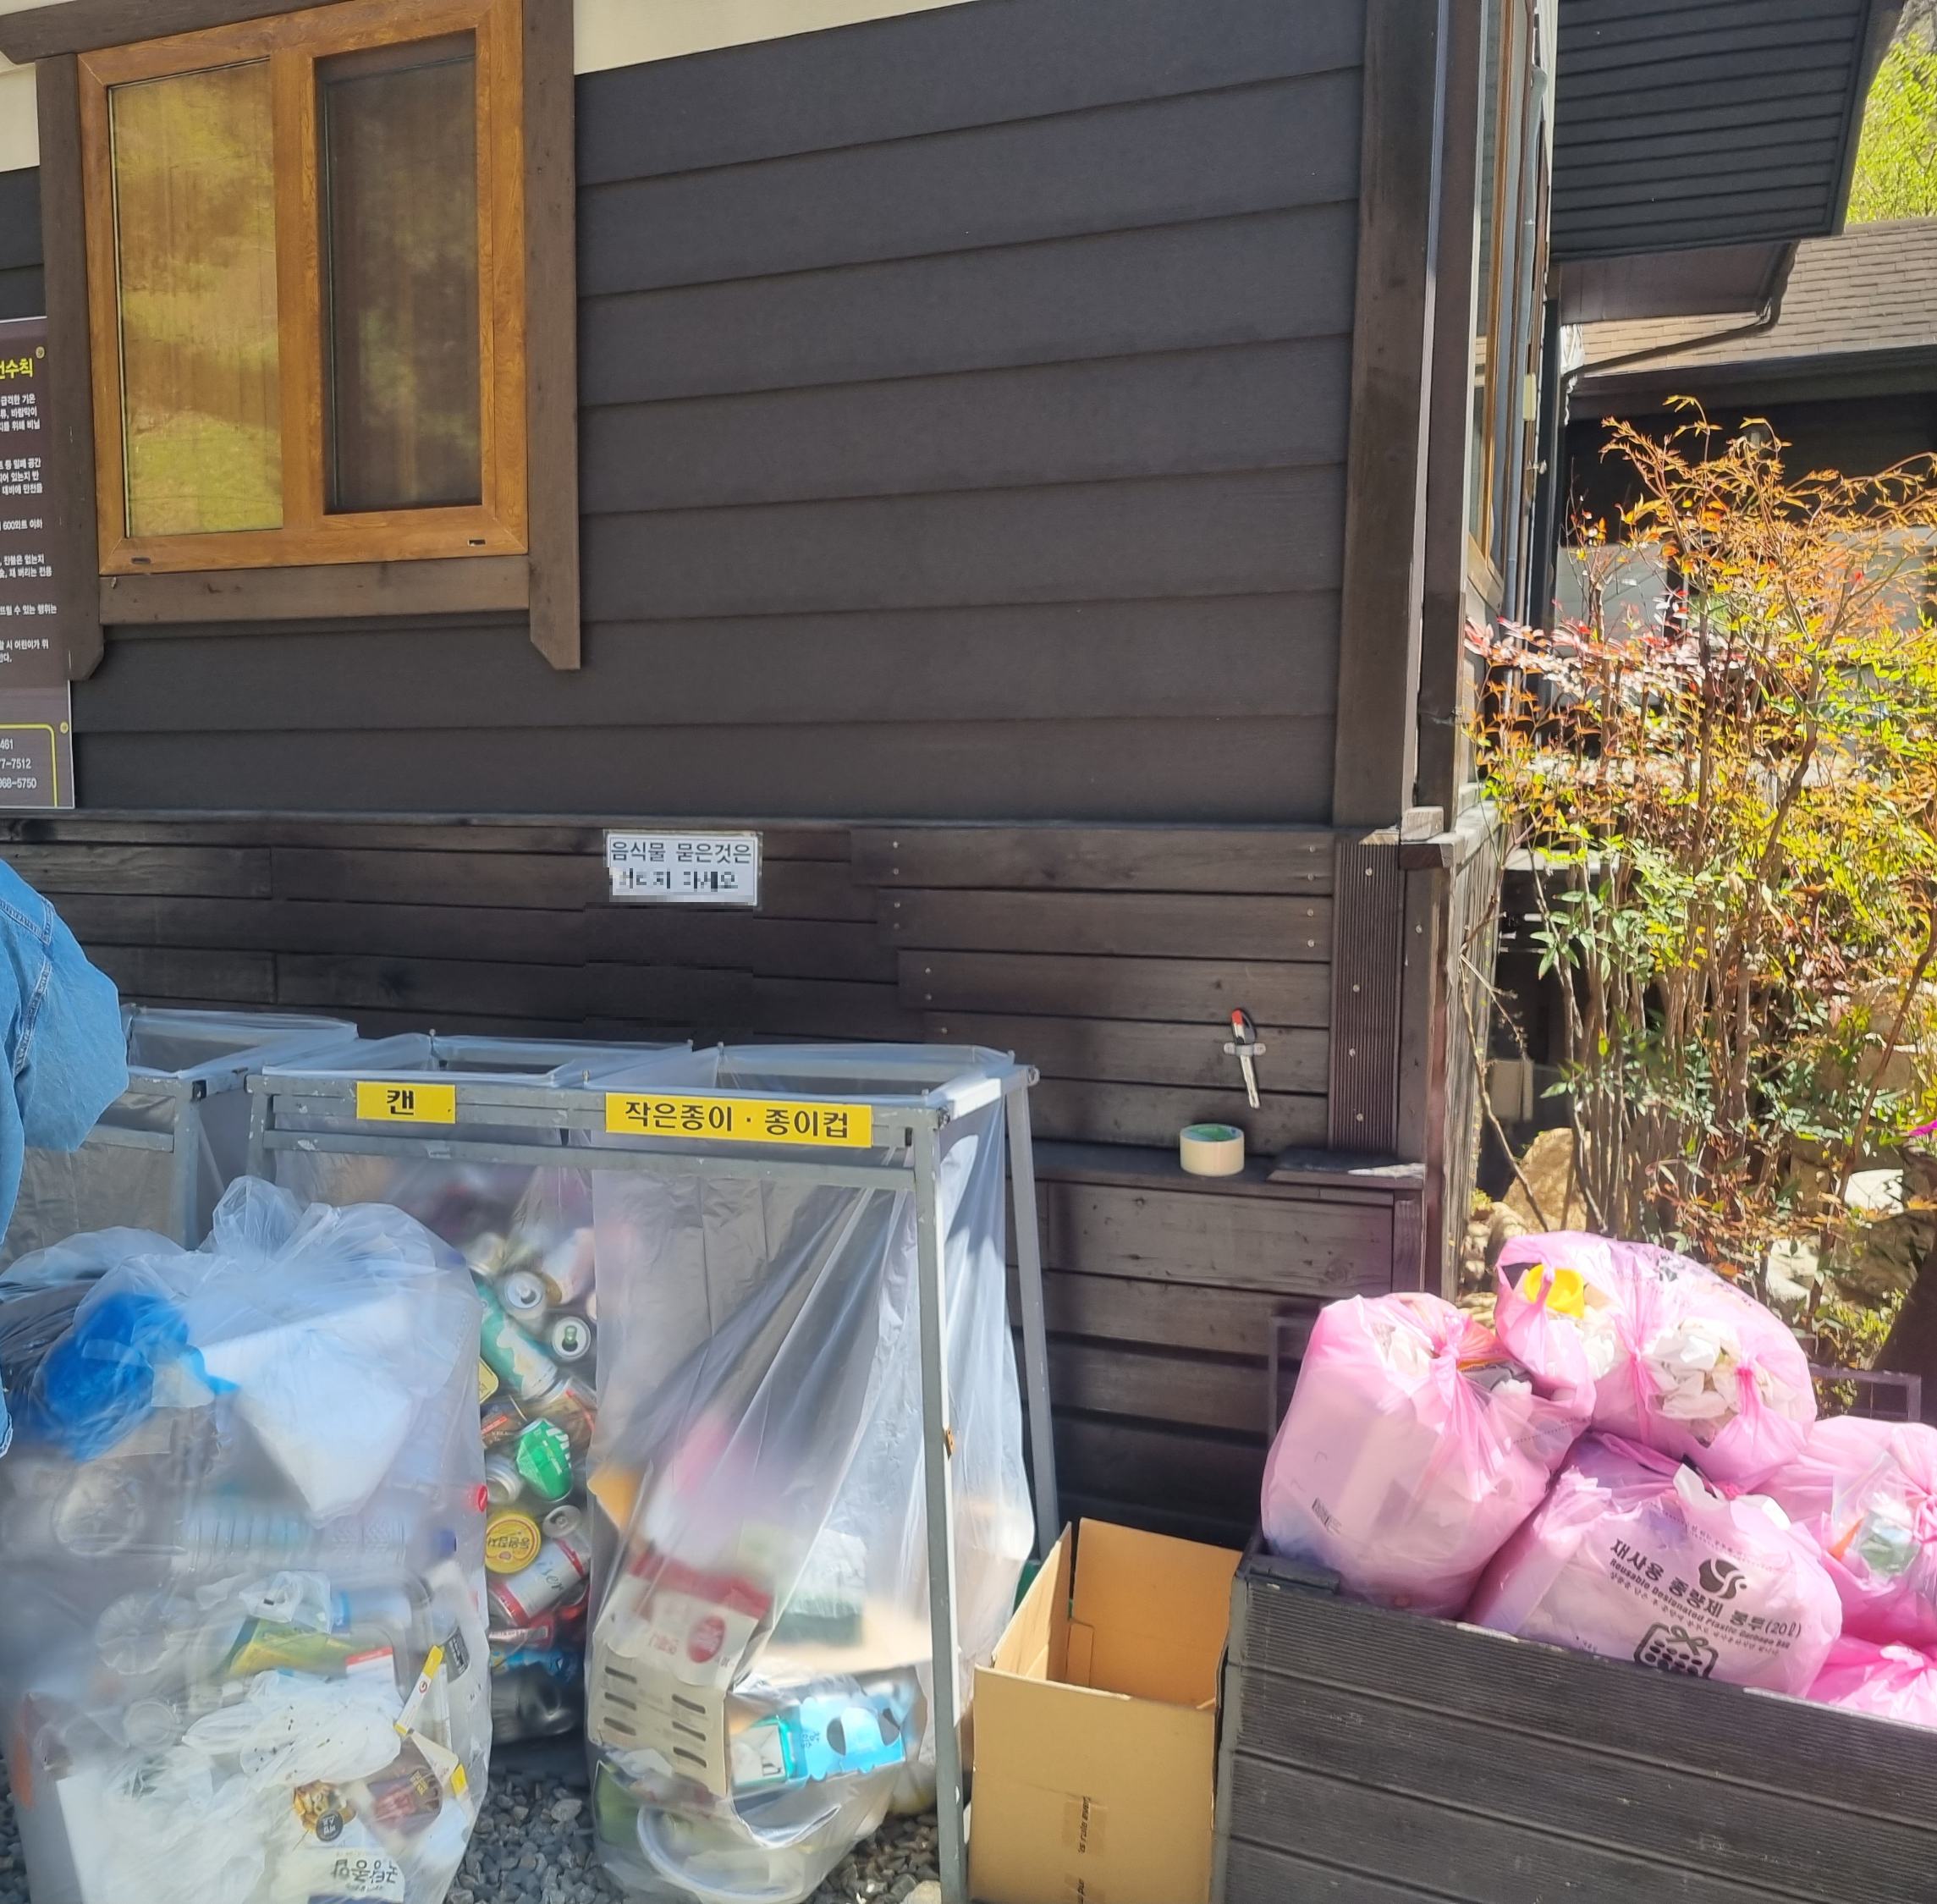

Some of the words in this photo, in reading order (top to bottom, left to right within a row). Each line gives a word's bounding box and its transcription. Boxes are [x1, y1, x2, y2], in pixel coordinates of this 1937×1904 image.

[22, 393, 36, 404] 기온
[11, 406, 37, 418] 바람막이
[27, 418, 41, 430] 비닐
[28, 456, 41, 468] 공간
[11, 470, 30, 482] 있는지
[2, 484, 22, 495] 대비에
[3, 520, 28, 531] 600와트
[30, 518, 43, 529] 이하
[14, 604, 21, 615] 수
[23, 604, 36, 614] 있는
[6, 640, 13, 650] 시
[14, 639, 40, 650] 어린이가
[611, 841, 666, 862] 음식물
[676, 843, 751, 864] 묻은것은
[386, 1089, 415, 1116] 캔
[625, 1101, 734, 1132] 작은종이
[764, 1109, 849, 1139] 종이컵
[1610, 1558, 1651, 1589] Reusable
[1610, 1538, 1665, 1582] 재사용
[1668, 1577, 1724, 1618] 종량제
